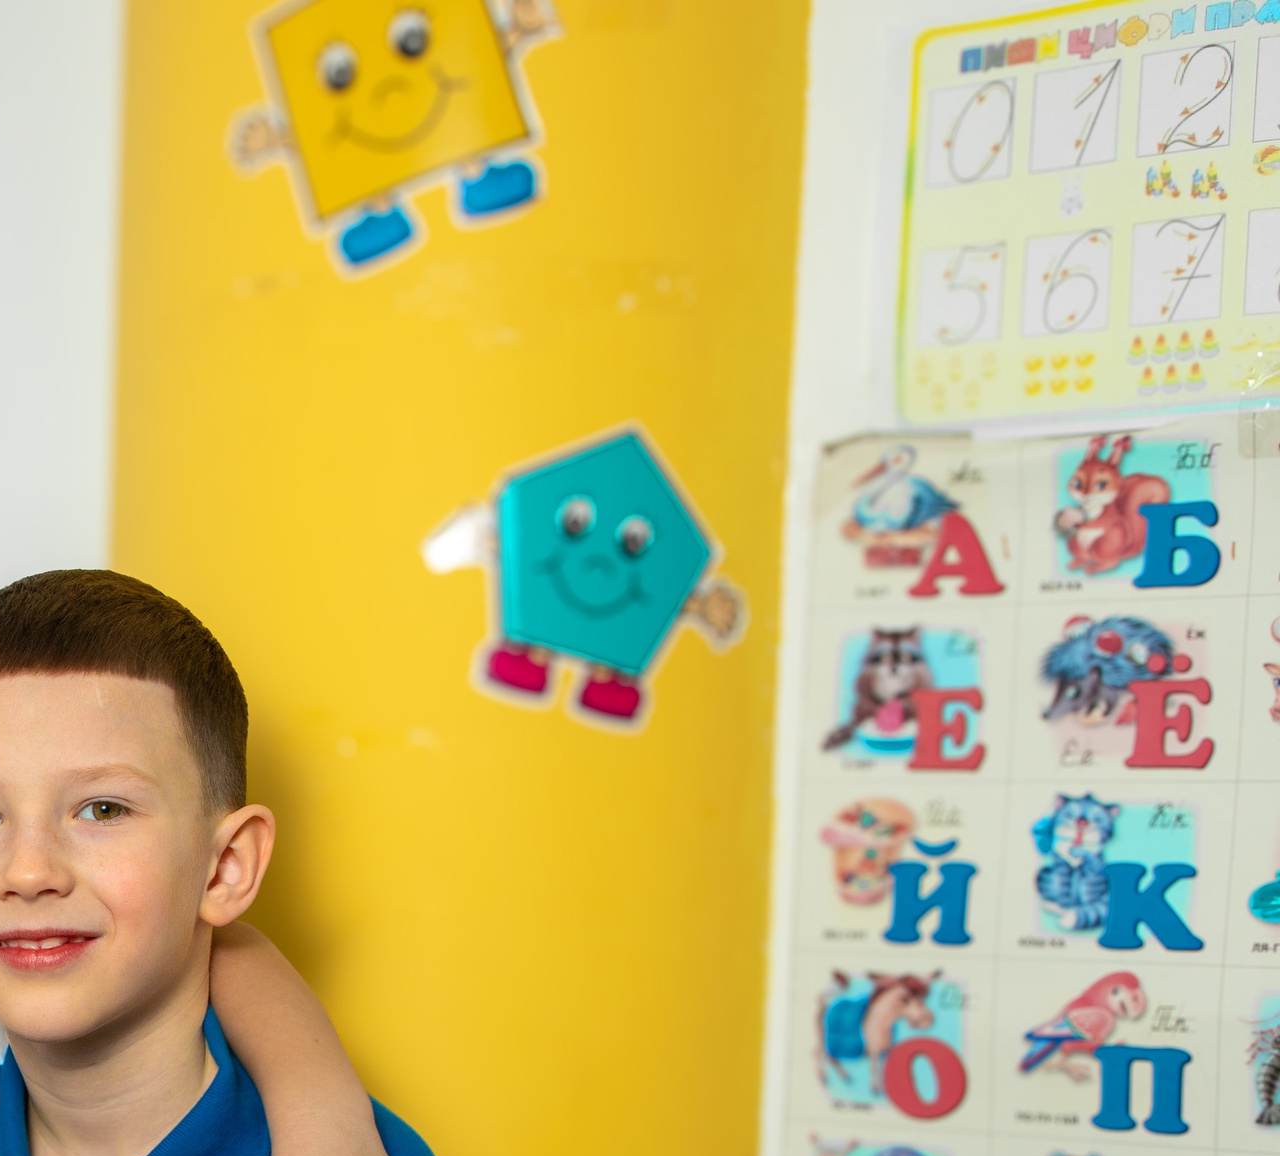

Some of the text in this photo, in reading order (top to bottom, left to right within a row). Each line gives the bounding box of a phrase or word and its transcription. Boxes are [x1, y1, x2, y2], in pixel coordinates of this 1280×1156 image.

[960, 30, 1061, 74] ПИШИ
[1074, 59, 1122, 167] 1
[1161, 44, 1235, 154] 2
[1042, 227, 1113, 334] 6
[1156, 213, 1227, 322] 7
[906, 500, 1221, 598] А Б
[906, 653, 1214, 771] Е Ё
[883, 837, 1205, 950] Й К
[882, 1036, 1192, 1134] О П
